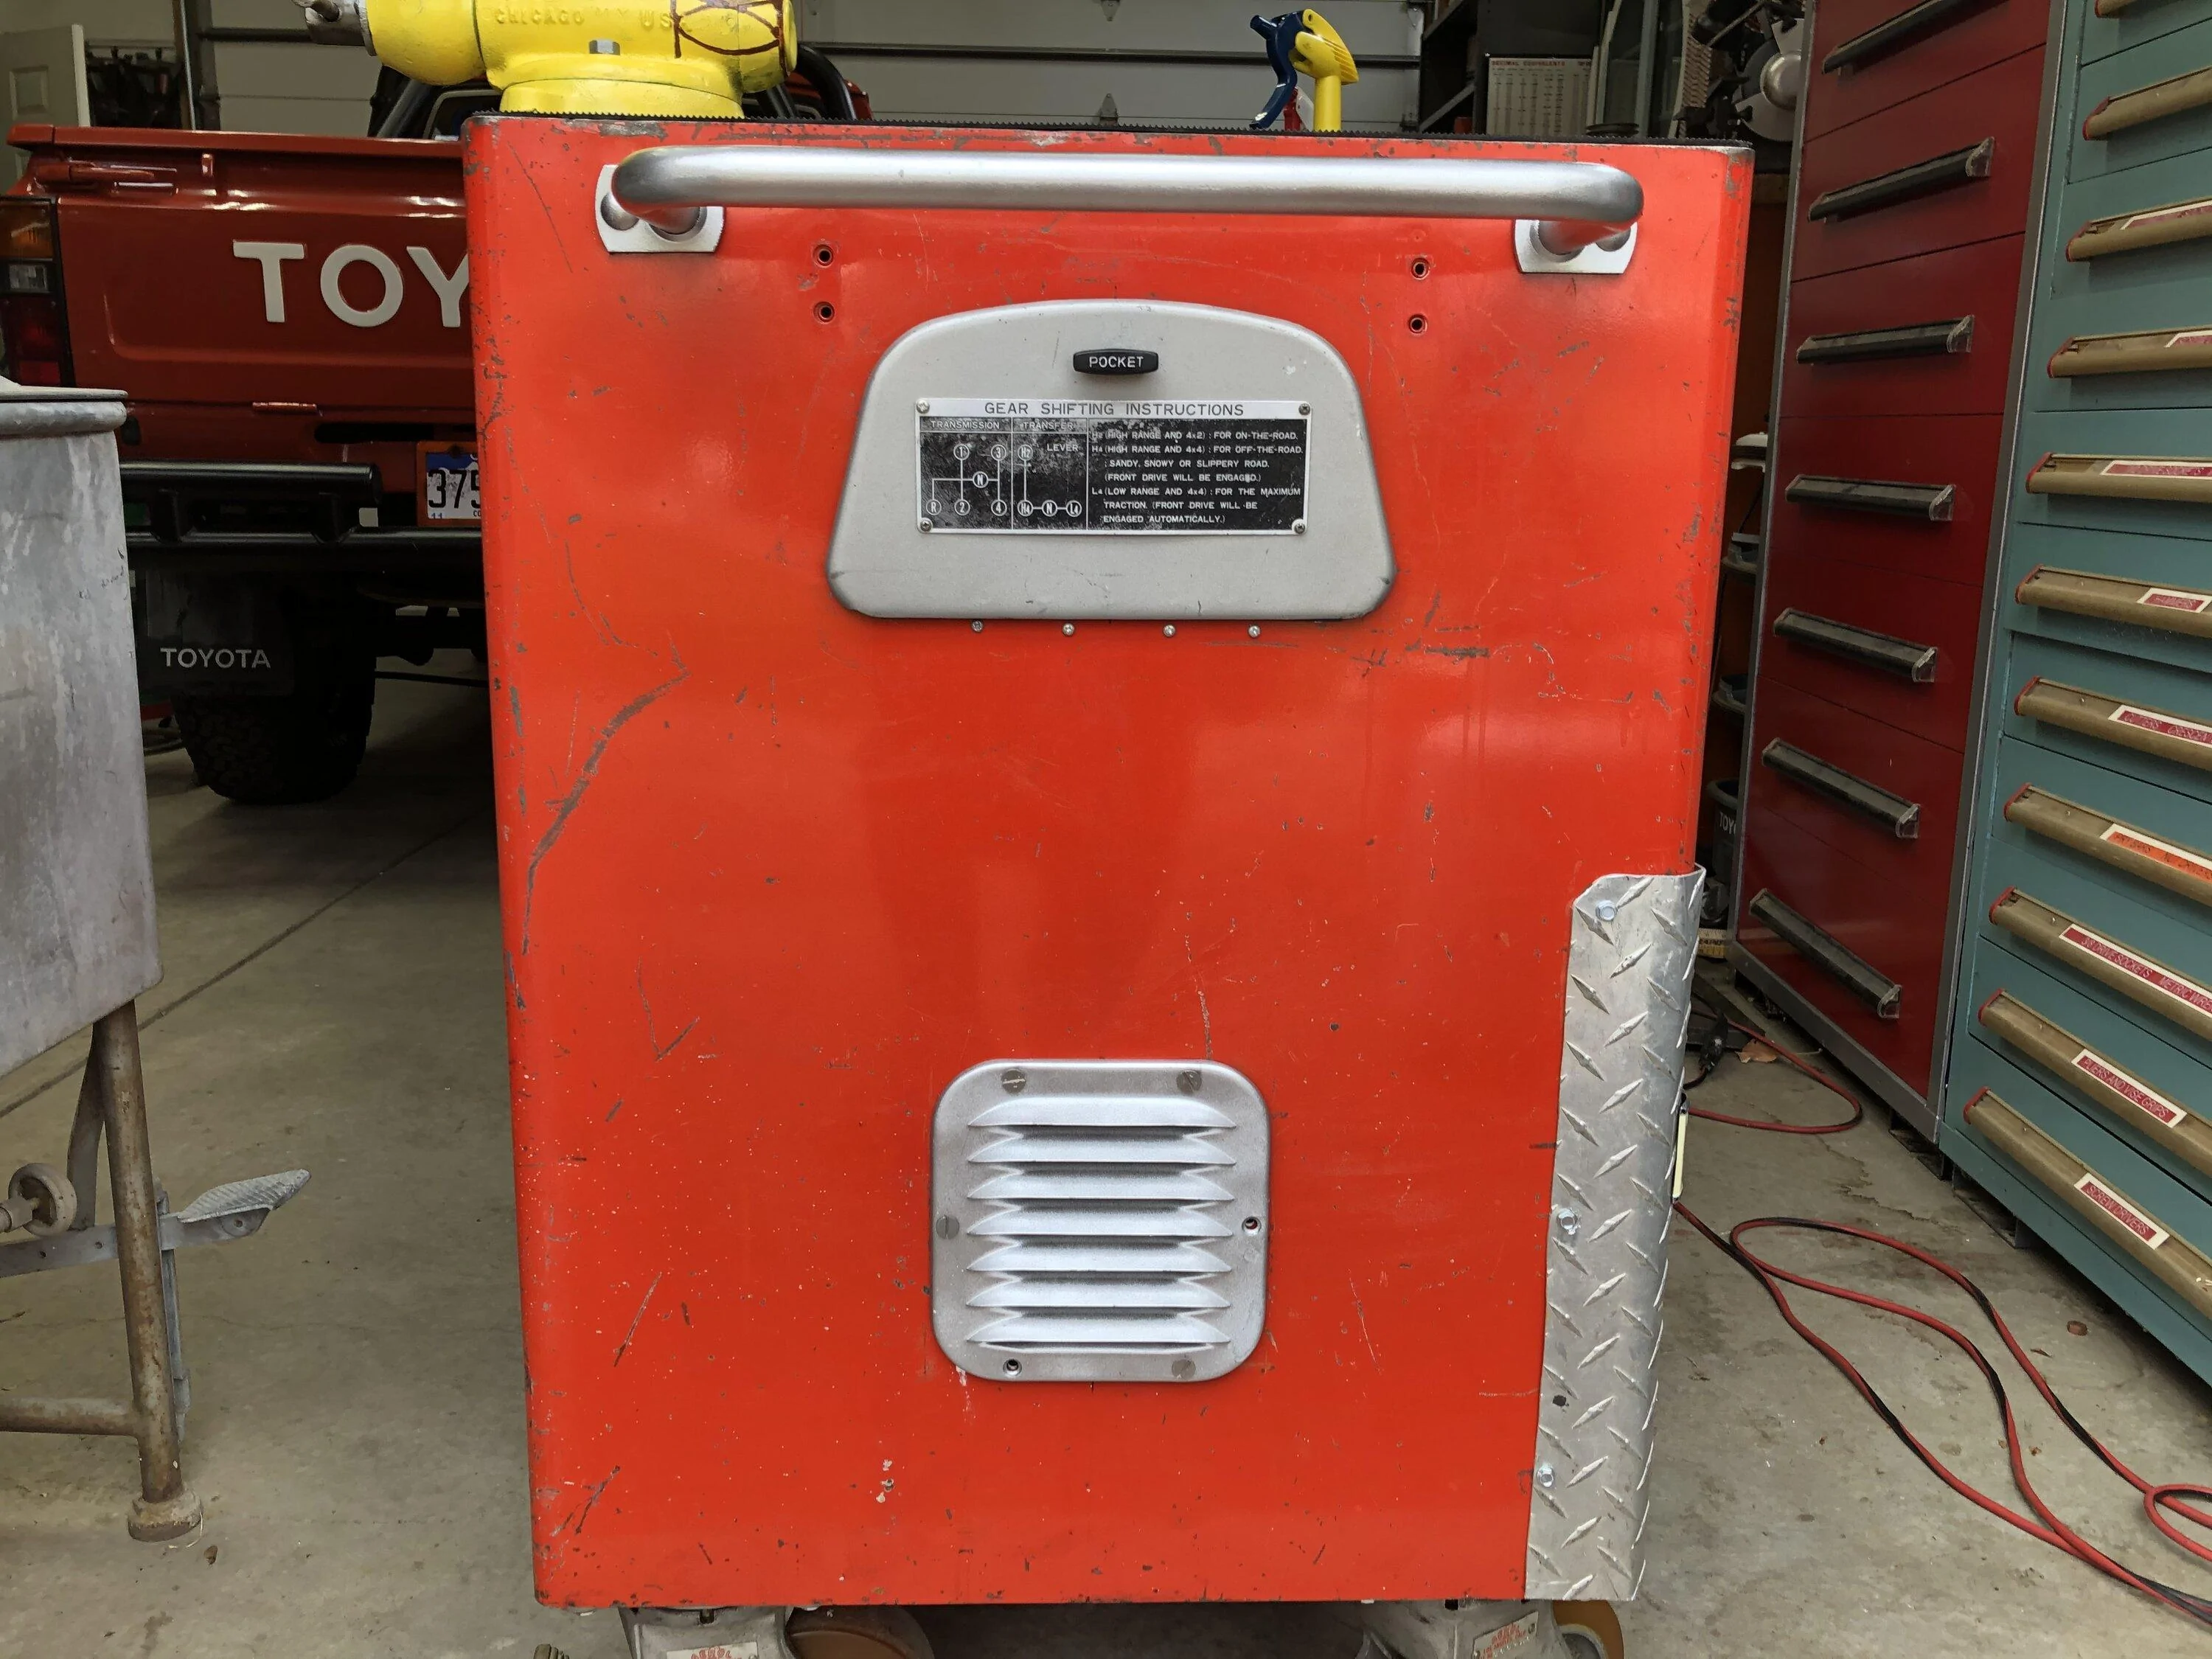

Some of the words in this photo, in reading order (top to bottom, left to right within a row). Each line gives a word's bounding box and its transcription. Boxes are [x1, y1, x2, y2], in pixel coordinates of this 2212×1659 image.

[495, 8, 585, 25] CHICAGO
[232, 240, 469, 327] TOY
[1089, 355, 1144, 368] POCKET
[984, 403, 1029, 414] GEAR
[1040, 403, 1114, 415] SHIFTING
[1125, 403, 1244, 416] INSTRUCTIONS
[931, 420, 1000, 429] TRANSMISSION
[1105, 431, 1128, 439] (HIGH
[1132, 431, 1161, 439] RANGE
[1164, 431, 1183, 439] AND
[1214, 431, 1232, 439] FOR
[959, 448, 964, 458] 1
[995, 448, 1001, 458] 3
[1022, 448, 1030, 458] H2
[1047, 444, 1079, 452] LEVER
[1105, 445, 1128, 453] (HIGH
[1132, 445, 1161, 453] RANGE
[1164, 445, 1183, 453] AND
[1186, 445, 1206, 454] 4x4)
[1213, 445, 1231, 453] FOR
[1144, 459, 1174, 467] SNOWY
[1179, 459, 1192, 467] OR
[1197, 459, 1239, 467] SLIPPERY
[978, 474, 983, 485] N
[1105, 473, 1137, 481] (FRONT
[1142, 473, 1167, 481] DRIVE
[1173, 473, 1194, 481] WILL
[1105, 487, 1126, 495] (LOW
[1130, 487, 1160, 495] RANGE
[1165, 487, 1183, 495] AND
[1187, 487, 1207, 496] 4x4)
[1260, 488, 1301, 496] MAXIMUM
[931, 502, 936, 512] R
[959, 502, 965, 512] 2
[995, 502, 1001, 512] 4
[1021, 502, 1030, 514] H4
[1047, 502, 1052, 513] N
[1071, 503, 1079, 514] L4
[1104, 501, 1147, 509] TRACTION.
[1152, 501, 1184, 509] (FRONT
[1189, 501, 1214, 509] DRIVE
[1220, 501, 1240, 509] WILL
[1149, 515, 1225, 524] AUTOMATICALLY.)
[160, 647, 271, 669] TOYOTA
[1719, 811, 1736, 835] TOY
[2115, 954, 2153, 978] SOCKETS
[2159, 976, 2193, 998] METRIC
[2189, 992, 2212, 1012] WRE
[2084, 1059, 2110, 1079] PLIERS
[2108, 1077, 2126, 1091] AND
[2124, 1085, 2143, 1102] VISE
[2141, 1097, 2169, 1119] GRIPS
[2087, 1185, 2117, 1211] SCREW
[2112, 1206, 2149, 1235] DRIVERS
